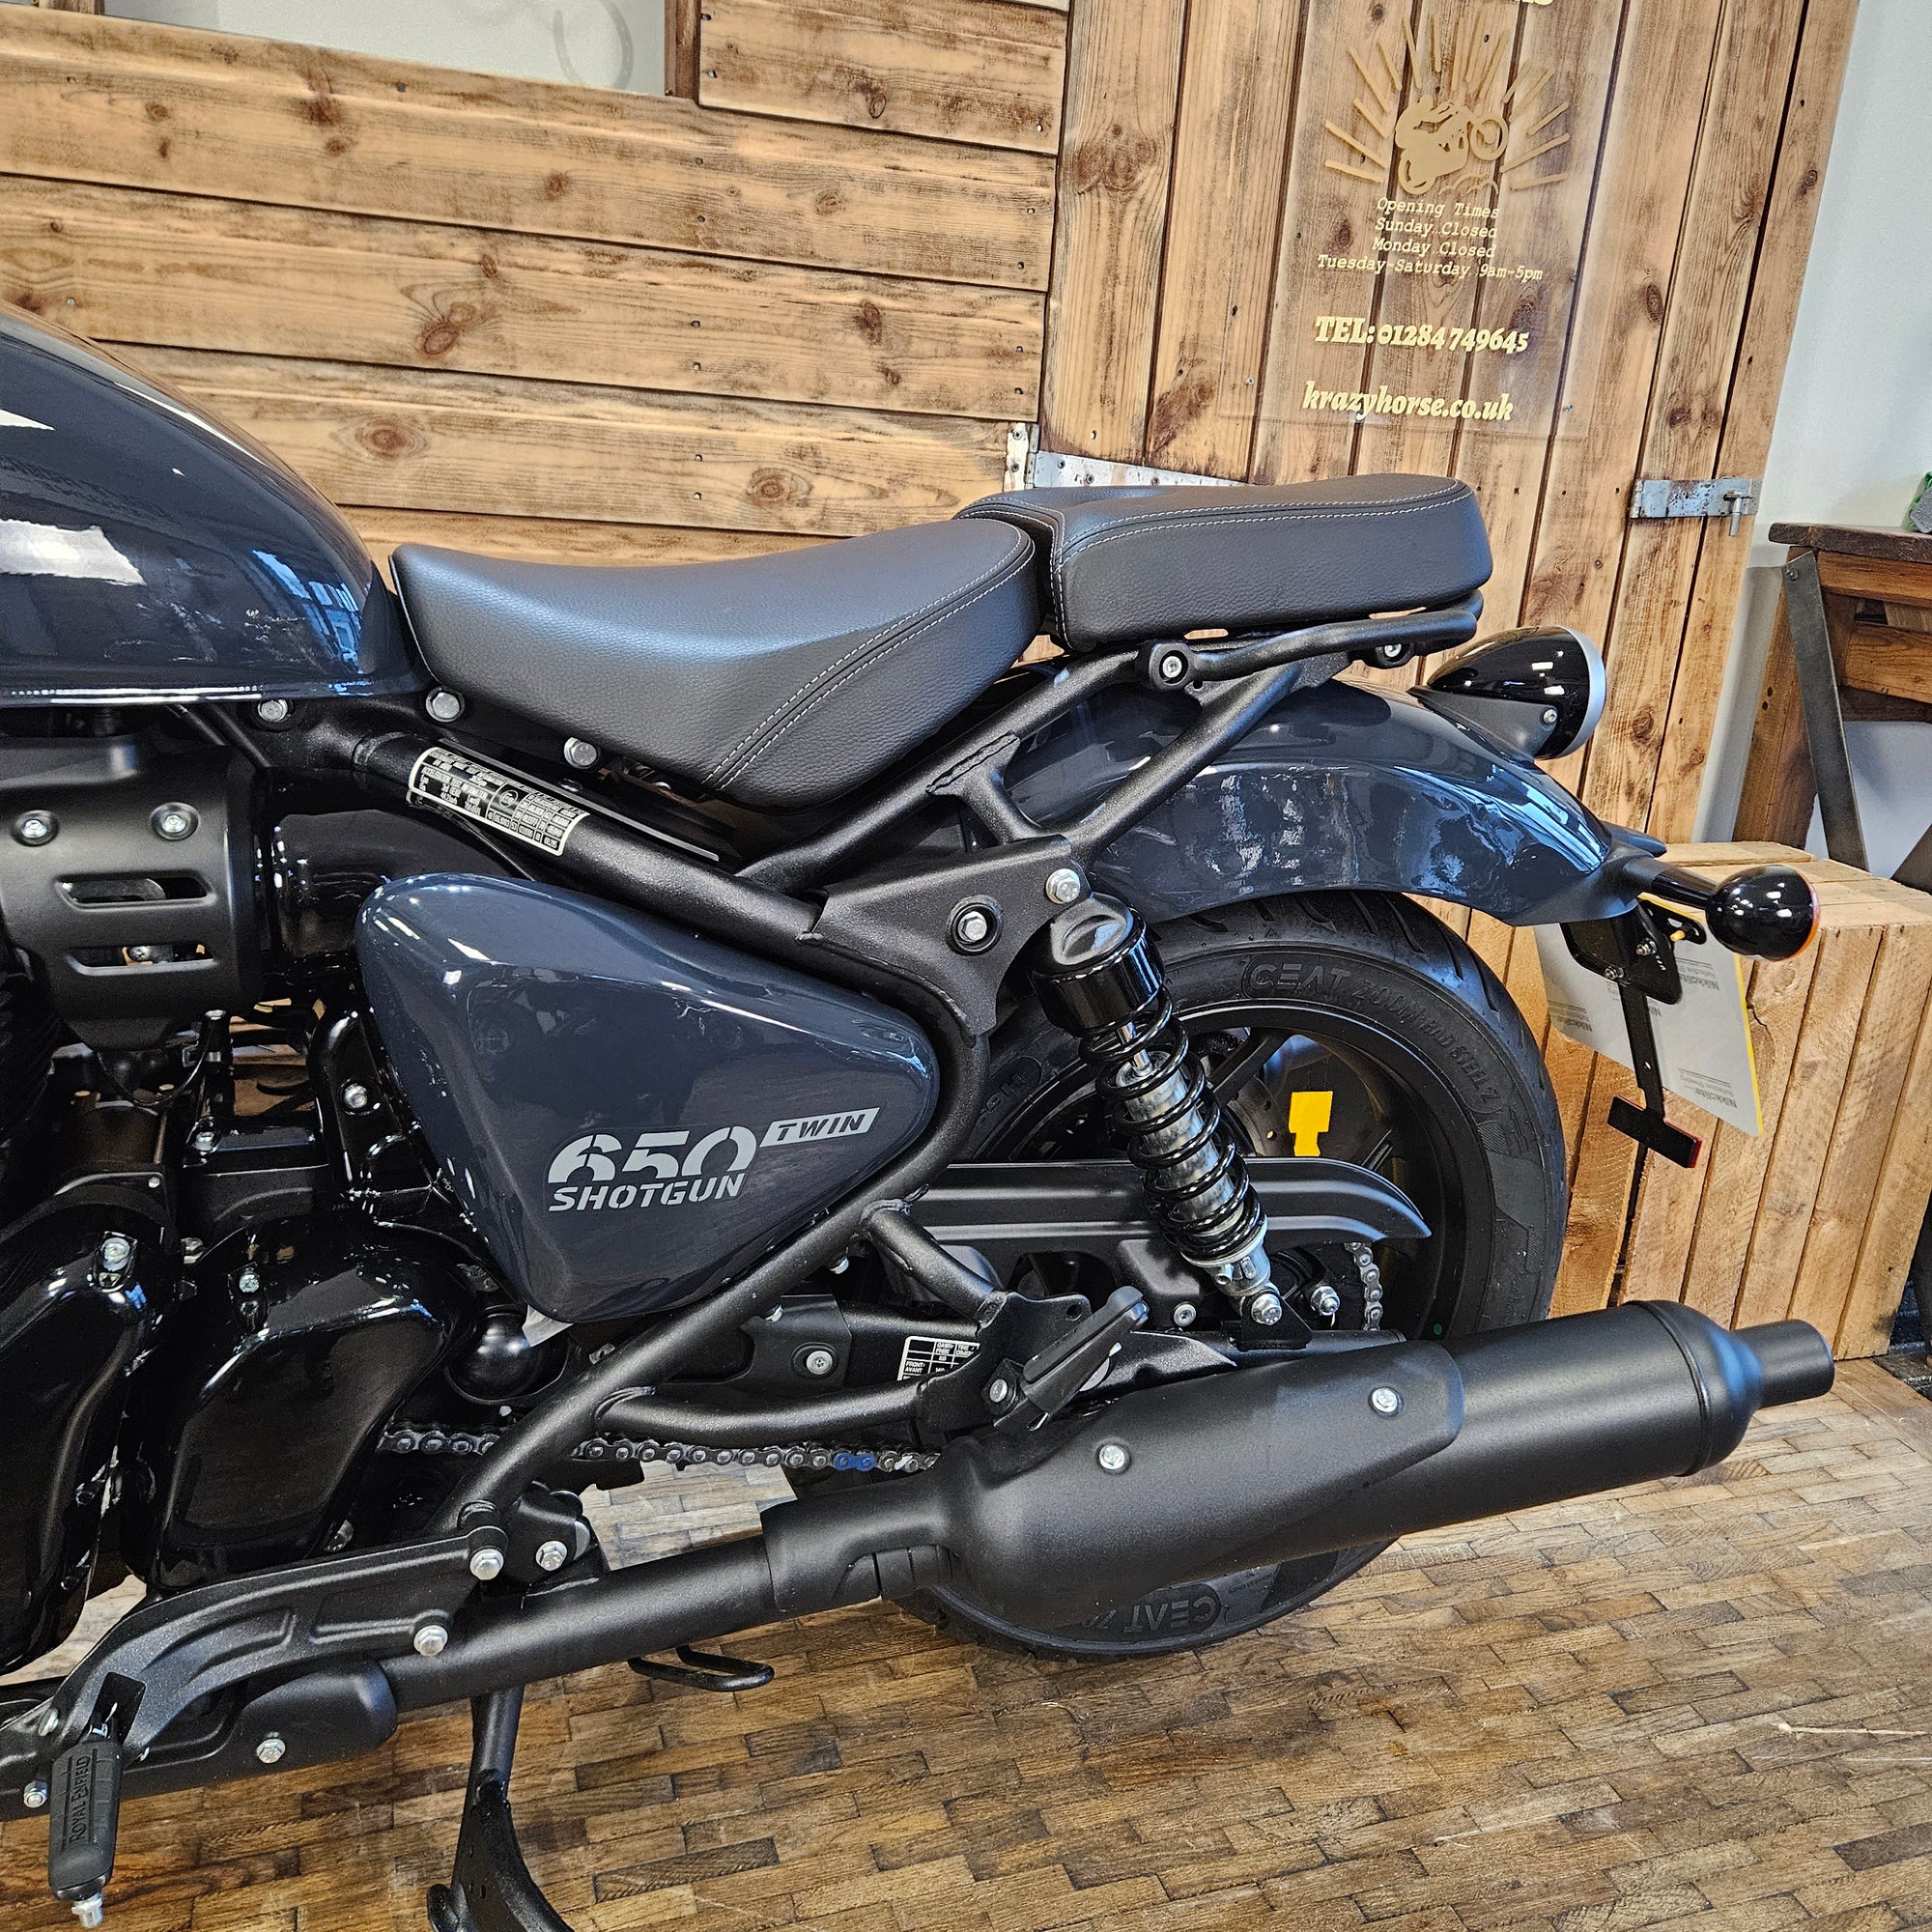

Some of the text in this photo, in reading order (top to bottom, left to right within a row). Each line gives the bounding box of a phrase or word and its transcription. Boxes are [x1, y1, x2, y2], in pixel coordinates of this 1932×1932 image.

[1377, 197, 1500, 218] Opening Times
[1441, 221, 1498, 239] Closed
[1438, 242, 1496, 258] Closed
[1479, 263, 1544, 283] 9am-5pm
[1448, 327, 1530, 354] 749645
[1302, 381, 1514, 421] krazyhorse.co.uk
[1250, 962, 1351, 994] CEAT
[777, 1113, 867, 1143] TWIN
[548, 1125, 757, 1183] 650
[549, 1173, 746, 1212] SHOTGUN
[1123, 1595, 1216, 1634] CEAT
[69, 1755, 91, 1844] ROYAL ENFIELD
